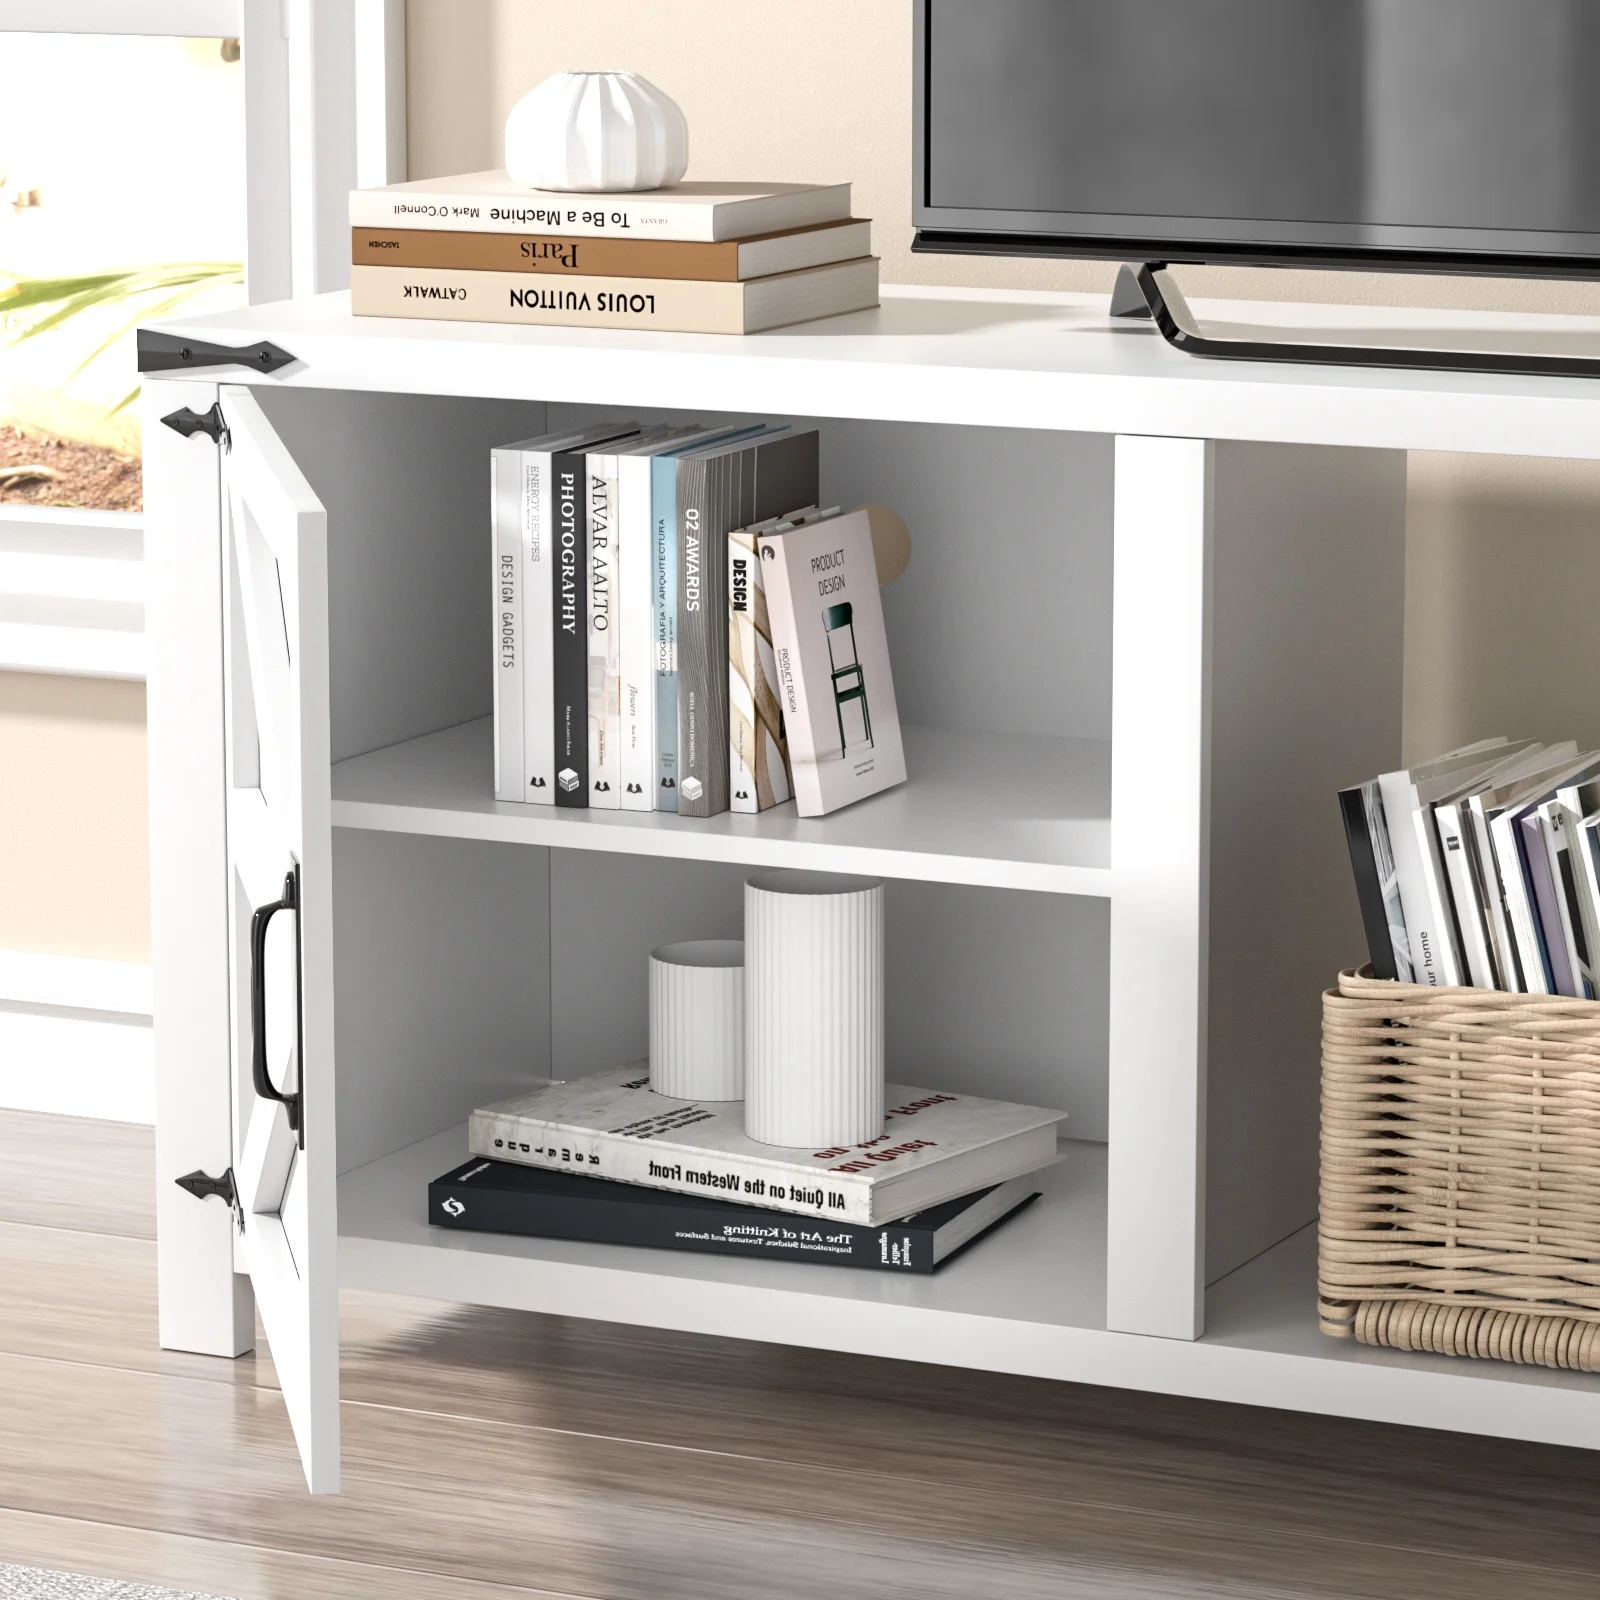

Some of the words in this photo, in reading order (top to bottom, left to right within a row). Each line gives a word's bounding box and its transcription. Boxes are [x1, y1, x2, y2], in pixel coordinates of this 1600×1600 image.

[394, 204, 449, 217] O'Connell
[452, 206, 480, 219] Mark
[490, 208, 561, 226] Machine
[567, 211, 577, 223] a
[582, 211, 605, 228] Be
[611, 212, 631, 228] To
[520, 241, 580, 269] Paris
[403, 285, 467, 301] CATWALK
[510, 288, 591, 311] VUITTON
[597, 292, 655, 314] LOUIS
[530, 465, 540, 511] ENERGY
[592, 475, 608, 550] ALVAR
[531, 514, 540, 562] RECIPES
[561, 472, 576, 635] PHOTOGRAPHY
[658, 518, 666, 600] ARQUITECTURA
[811, 549, 844, 574] PRODUCT
[501, 555, 514, 604] DESIGN
[686, 535, 700, 612] AWARDS
[733, 558, 747, 612] DESIGN
[818, 574, 846, 597] DESIGN
[593, 556, 608, 632] AALTO
[502, 612, 515, 668] GADGETS
[782, 648, 793, 683] PRODUCT
[786, 685, 797, 713] DESIGN
[1420, 931, 1433, 967] home
